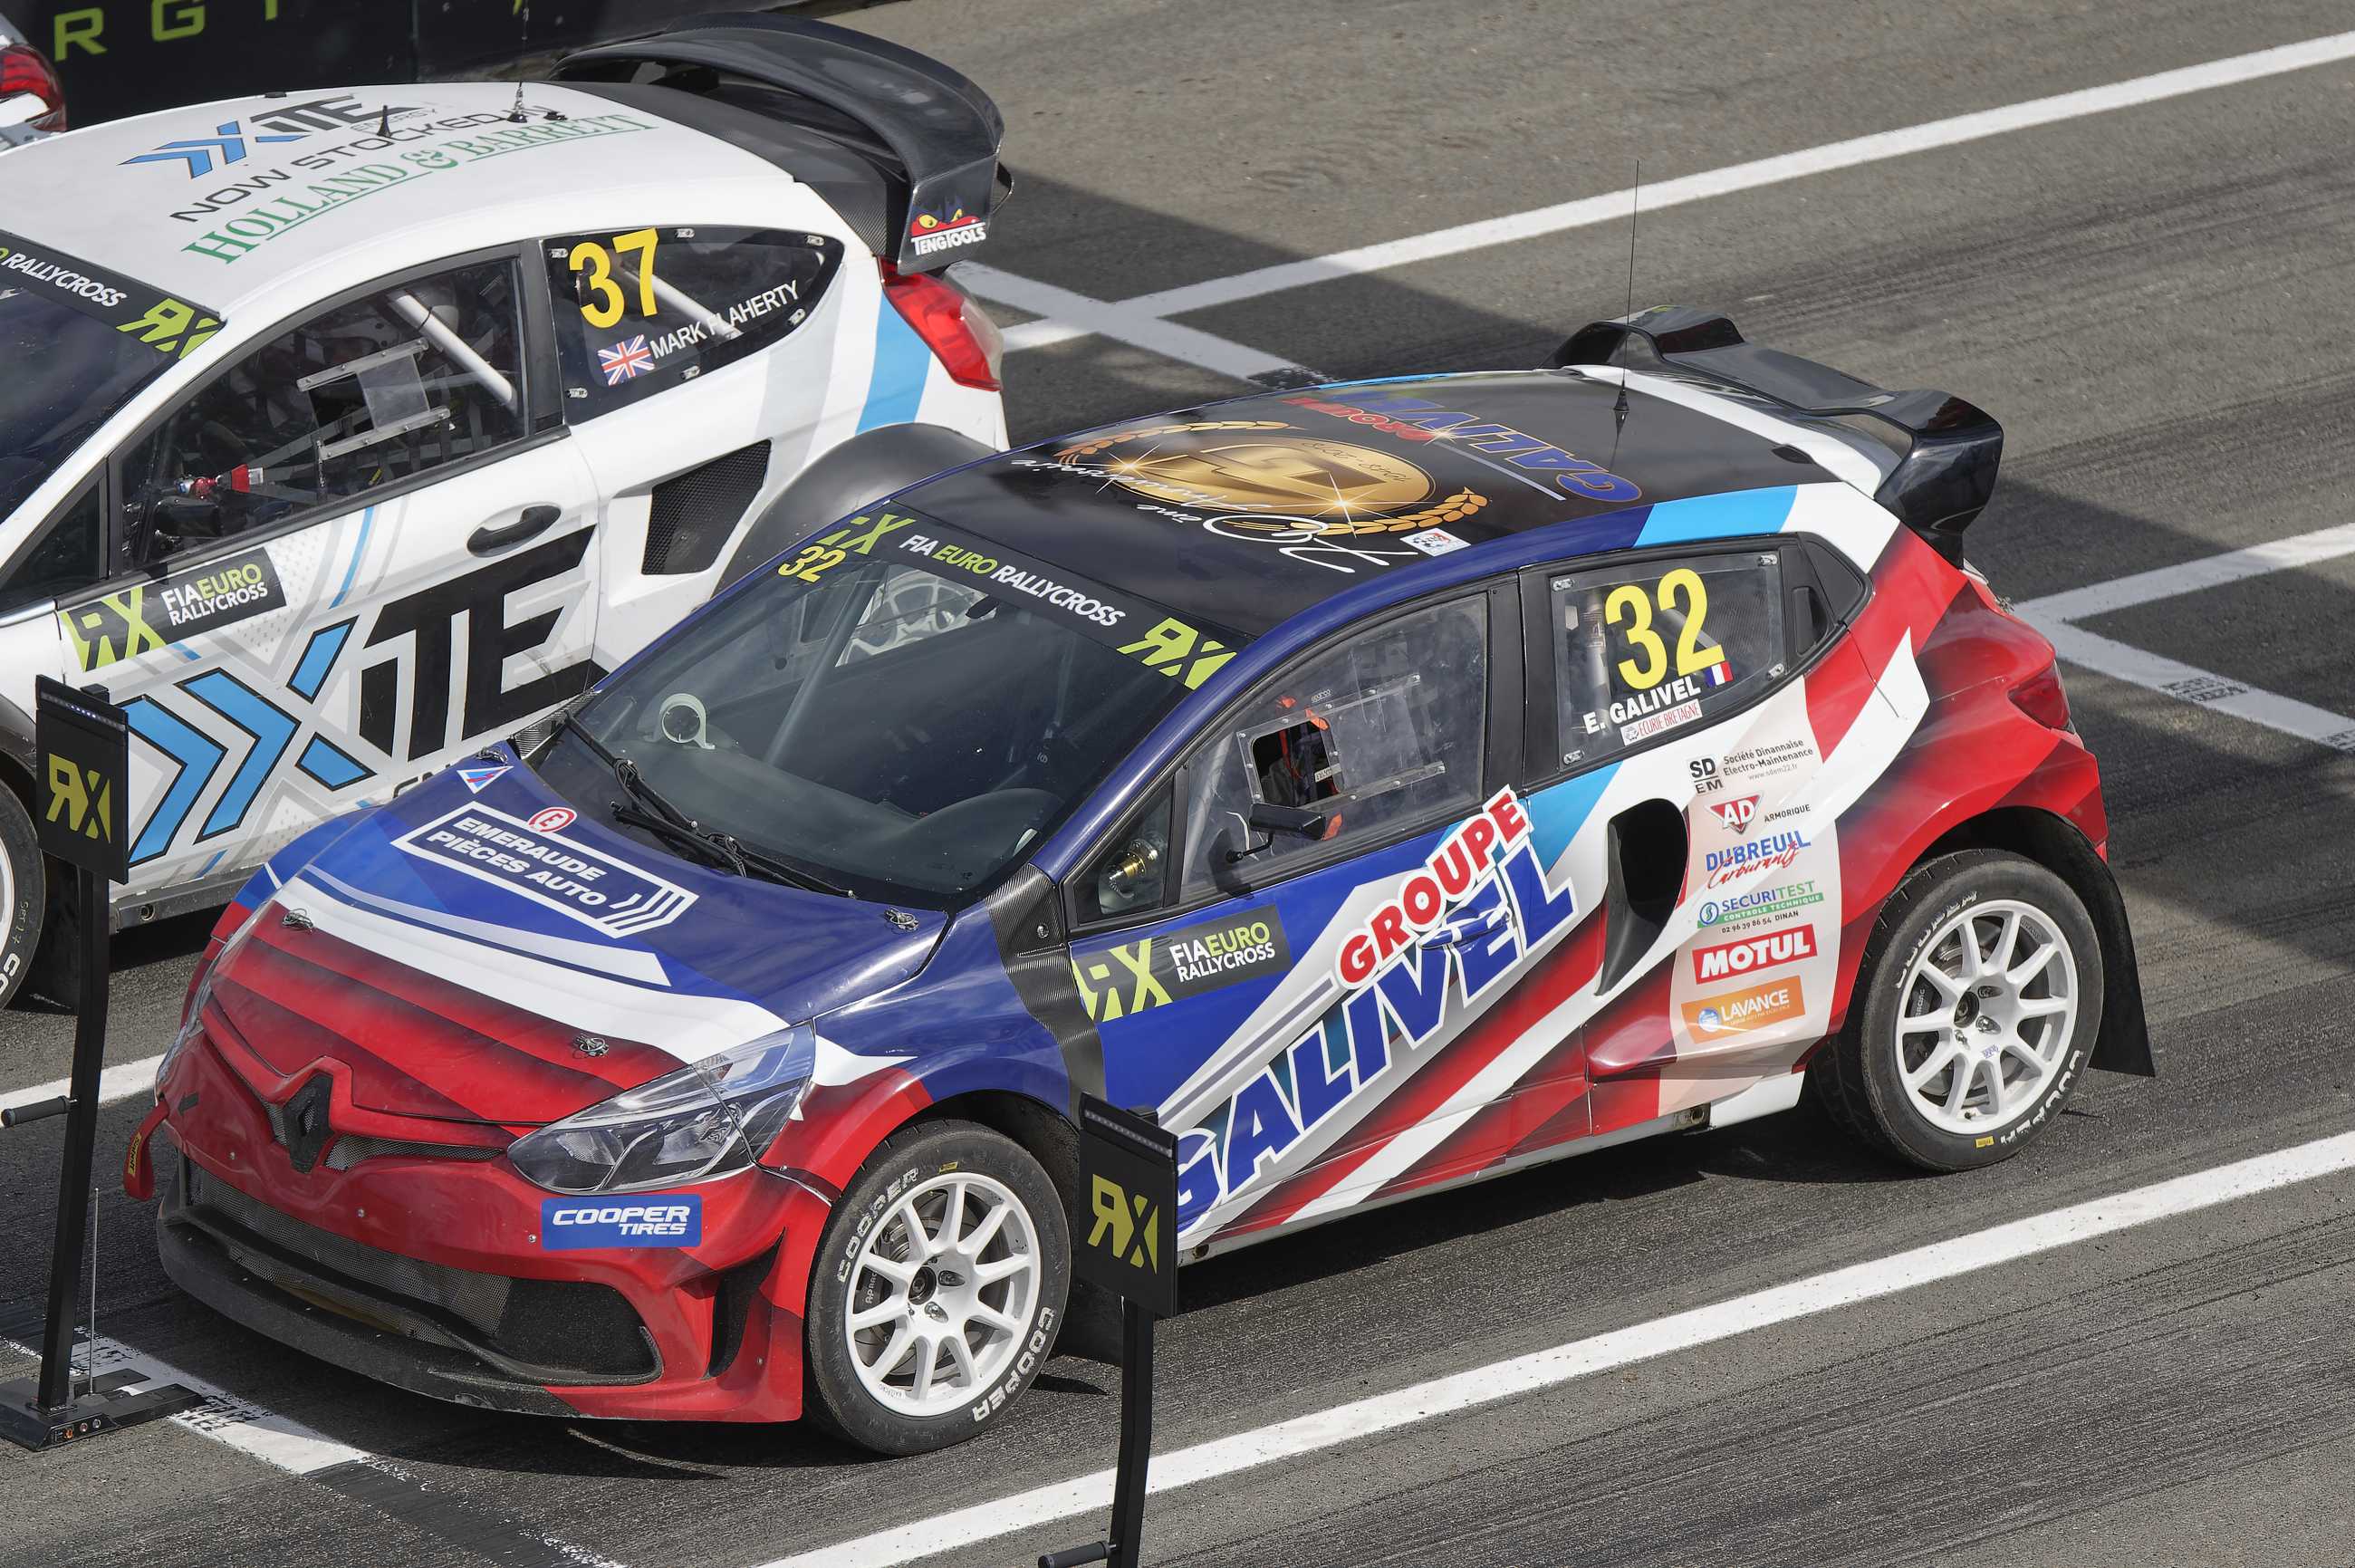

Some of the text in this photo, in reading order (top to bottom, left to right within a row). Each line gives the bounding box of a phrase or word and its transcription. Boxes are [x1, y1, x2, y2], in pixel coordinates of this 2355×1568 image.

[169, 168, 292, 223] NOW
[292, 113, 505, 169] STOCKED
[181, 114, 659, 265] HOLLAND & BARRETT
[1, 253, 128, 307] RALLYCROSS
[569, 227, 658, 329] 37
[116, 297, 220, 360] RX
[649, 322, 707, 360] MARK
[776, 545, 848, 583] 32
[899, 534, 1126, 628] FIA EURO RALLYCROSS
[59, 586, 167, 673] RX
[168, 582, 269, 626] RALLYCROSS
[1605, 568, 1725, 690] 32
[1115, 617, 1238, 691] RX
[1582, 676, 1702, 735] E. GALIVEL
[1689, 757, 1716, 779] SD
[1724, 738, 1804, 765] Société Dinannaise
[46, 753, 111, 844] RX
[1695, 779, 1725, 794] EM
[1721, 799, 1756, 829] AD
[1764, 803, 1812, 823] ARMORIQUE
[427, 830, 608, 907] PIÈCES AUTO
[453, 817, 608, 881] EMERAUDE
[1706, 830, 1812, 871] DUBREUIL
[1338, 786, 1533, 987] GROUPE
[1722, 880, 1815, 912] SECURITEST
[1770, 894, 1822, 910] TECHNIQUE
[1722, 926, 1731, 934] 02
[1732, 924, 1741, 933] 96
[1774, 910, 1799, 921] DINAN
[1072, 938, 1174, 1022] RX
[1176, 942, 1276, 983] RALLYCROSS
[1700, 930, 1811, 979] MOTUL
[1722, 988, 1790, 1023] LAVANCE
[1178, 842, 1578, 1239] GALIVEL
[552, 1206, 691, 1226] COOPER
[618, 1223, 688, 1236] TIRES
[836, 1167, 919, 1284] COOPER
[1087, 1173, 1159, 1275] RX
[972, 1306, 1055, 1423] COOPER
